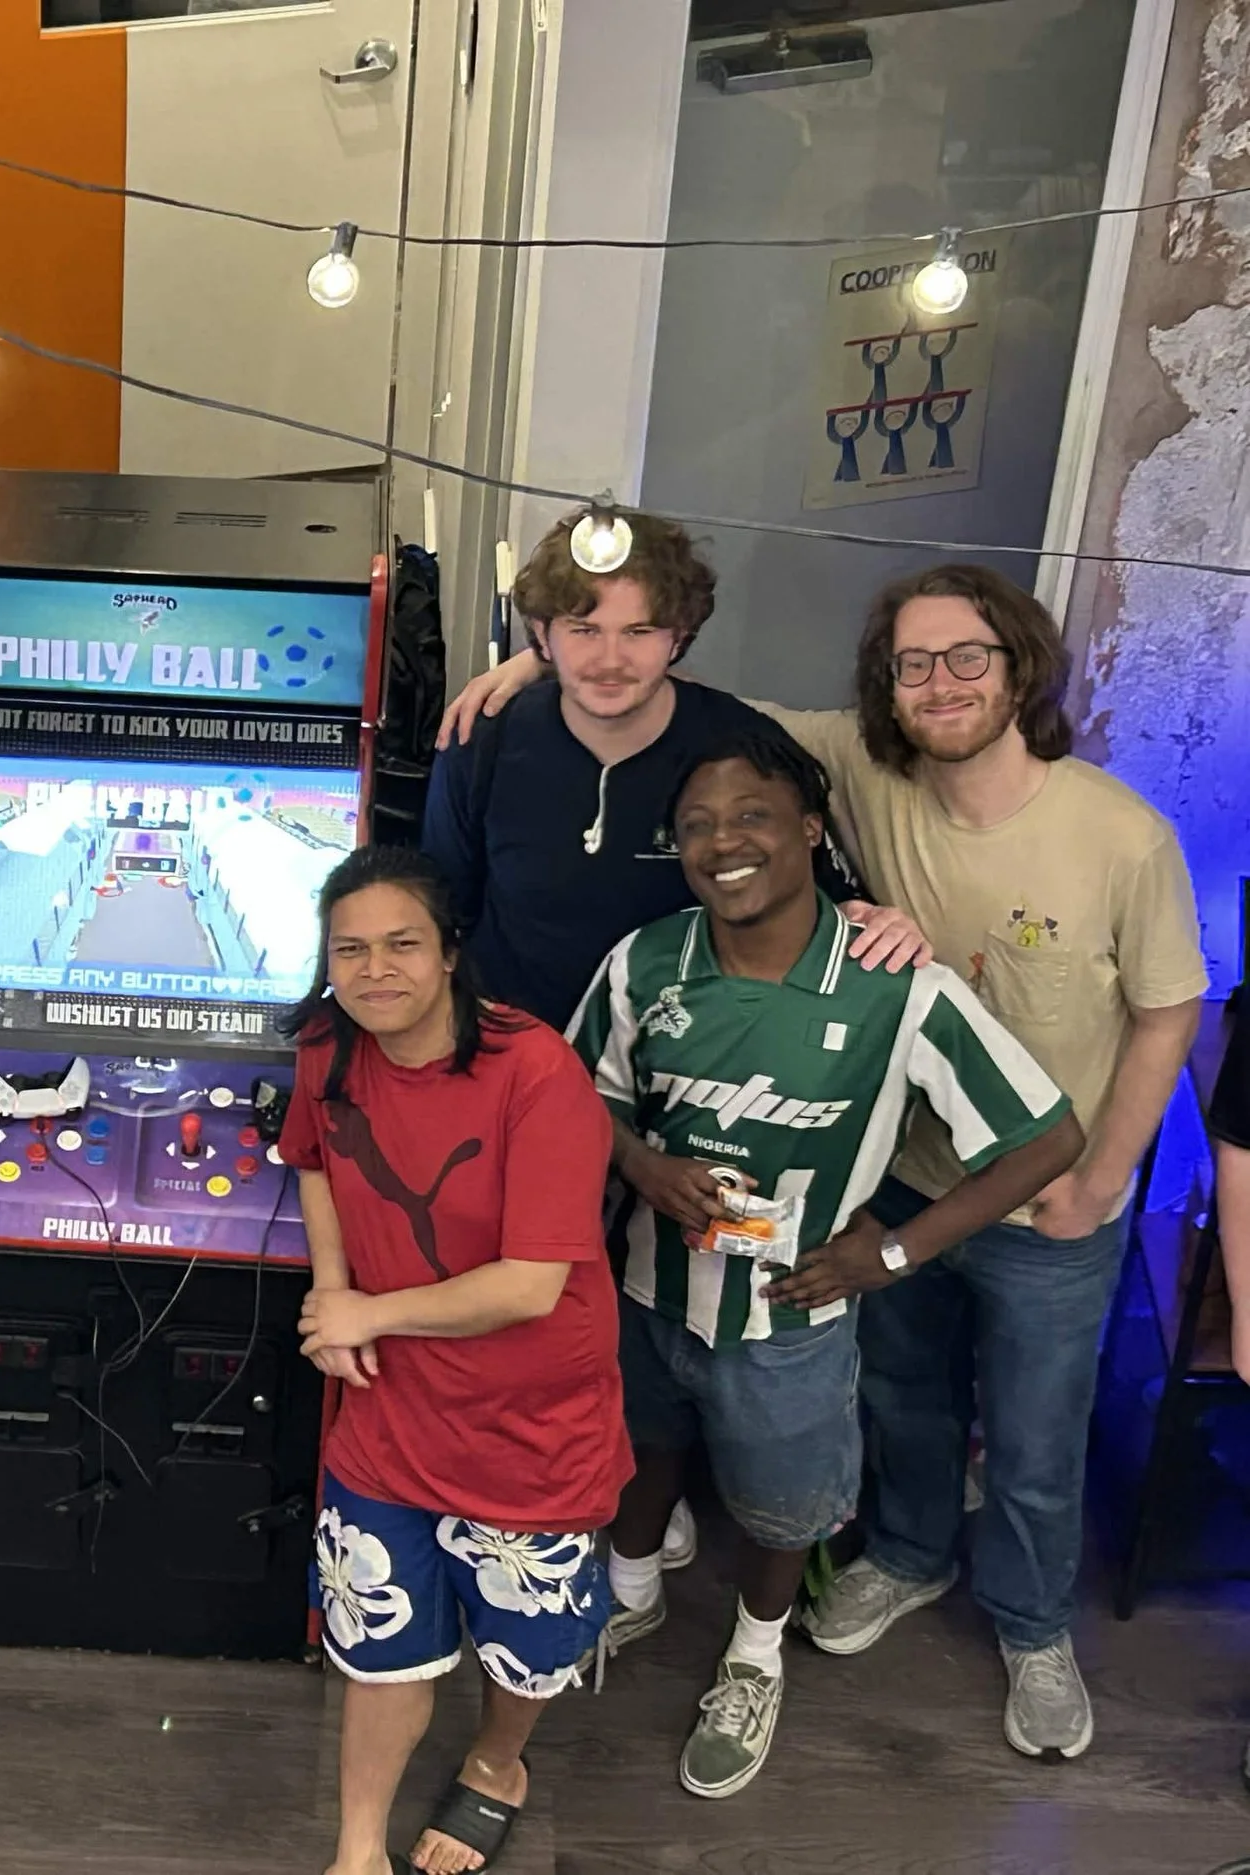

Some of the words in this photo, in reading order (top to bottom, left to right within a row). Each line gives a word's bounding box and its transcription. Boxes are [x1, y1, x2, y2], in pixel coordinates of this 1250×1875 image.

[151, 644, 263, 691] BALL
[27, 710, 95, 733] FORGET
[101, 714, 125, 735] TO
[129, 716, 170, 737] KICK
[175, 718, 228, 740] YOUR
[233, 720, 293, 743] LOVED
[297, 723, 344, 744] ONES
[69, 969, 114, 988] ANY
[121, 971, 212, 993] BUTTON
[46, 1002, 132, 1028] WISHLIST
[138, 1007, 162, 1029] US
[166, 1009, 193, 1031] ON
[197, 1011, 263, 1034] STEAM
[688, 1133, 750, 1158] NIGERIA
[43, 1217, 116, 1242] PHILLY
[120, 1223, 174, 1246] BALL
